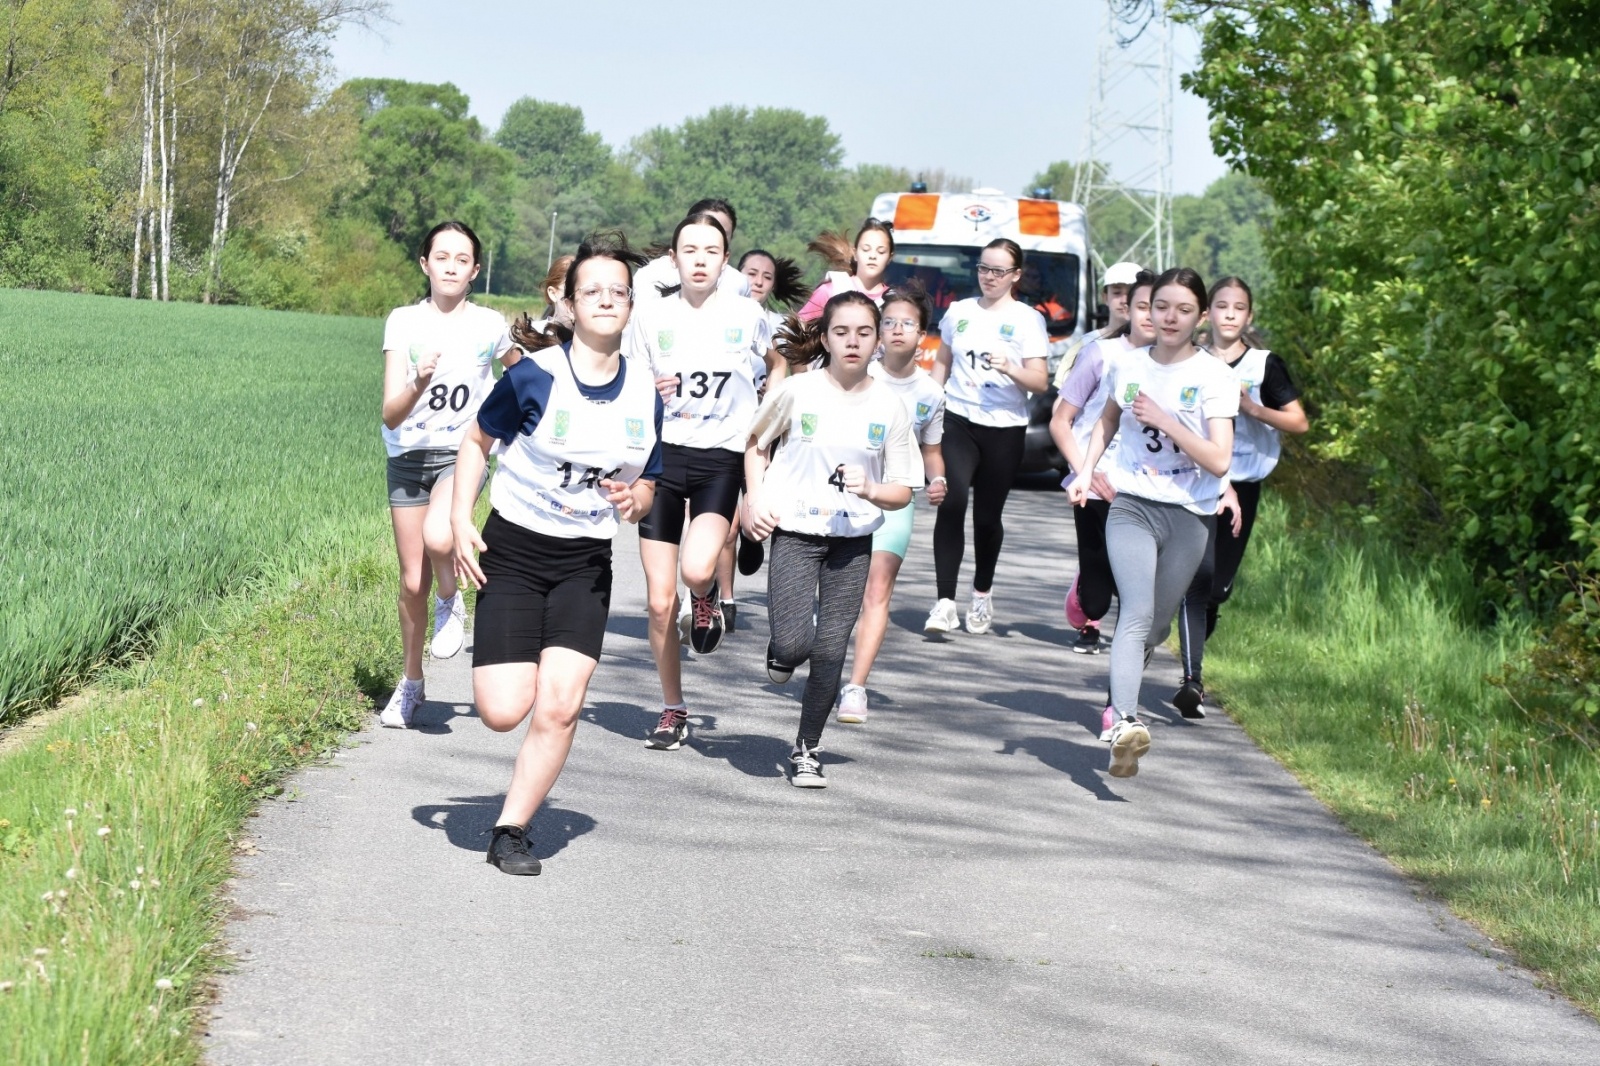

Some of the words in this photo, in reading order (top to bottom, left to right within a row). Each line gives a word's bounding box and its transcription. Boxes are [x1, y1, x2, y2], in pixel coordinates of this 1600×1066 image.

[428, 384, 470, 412] 80
[674, 371, 732, 399] 137
[828, 463, 845, 493] 4
